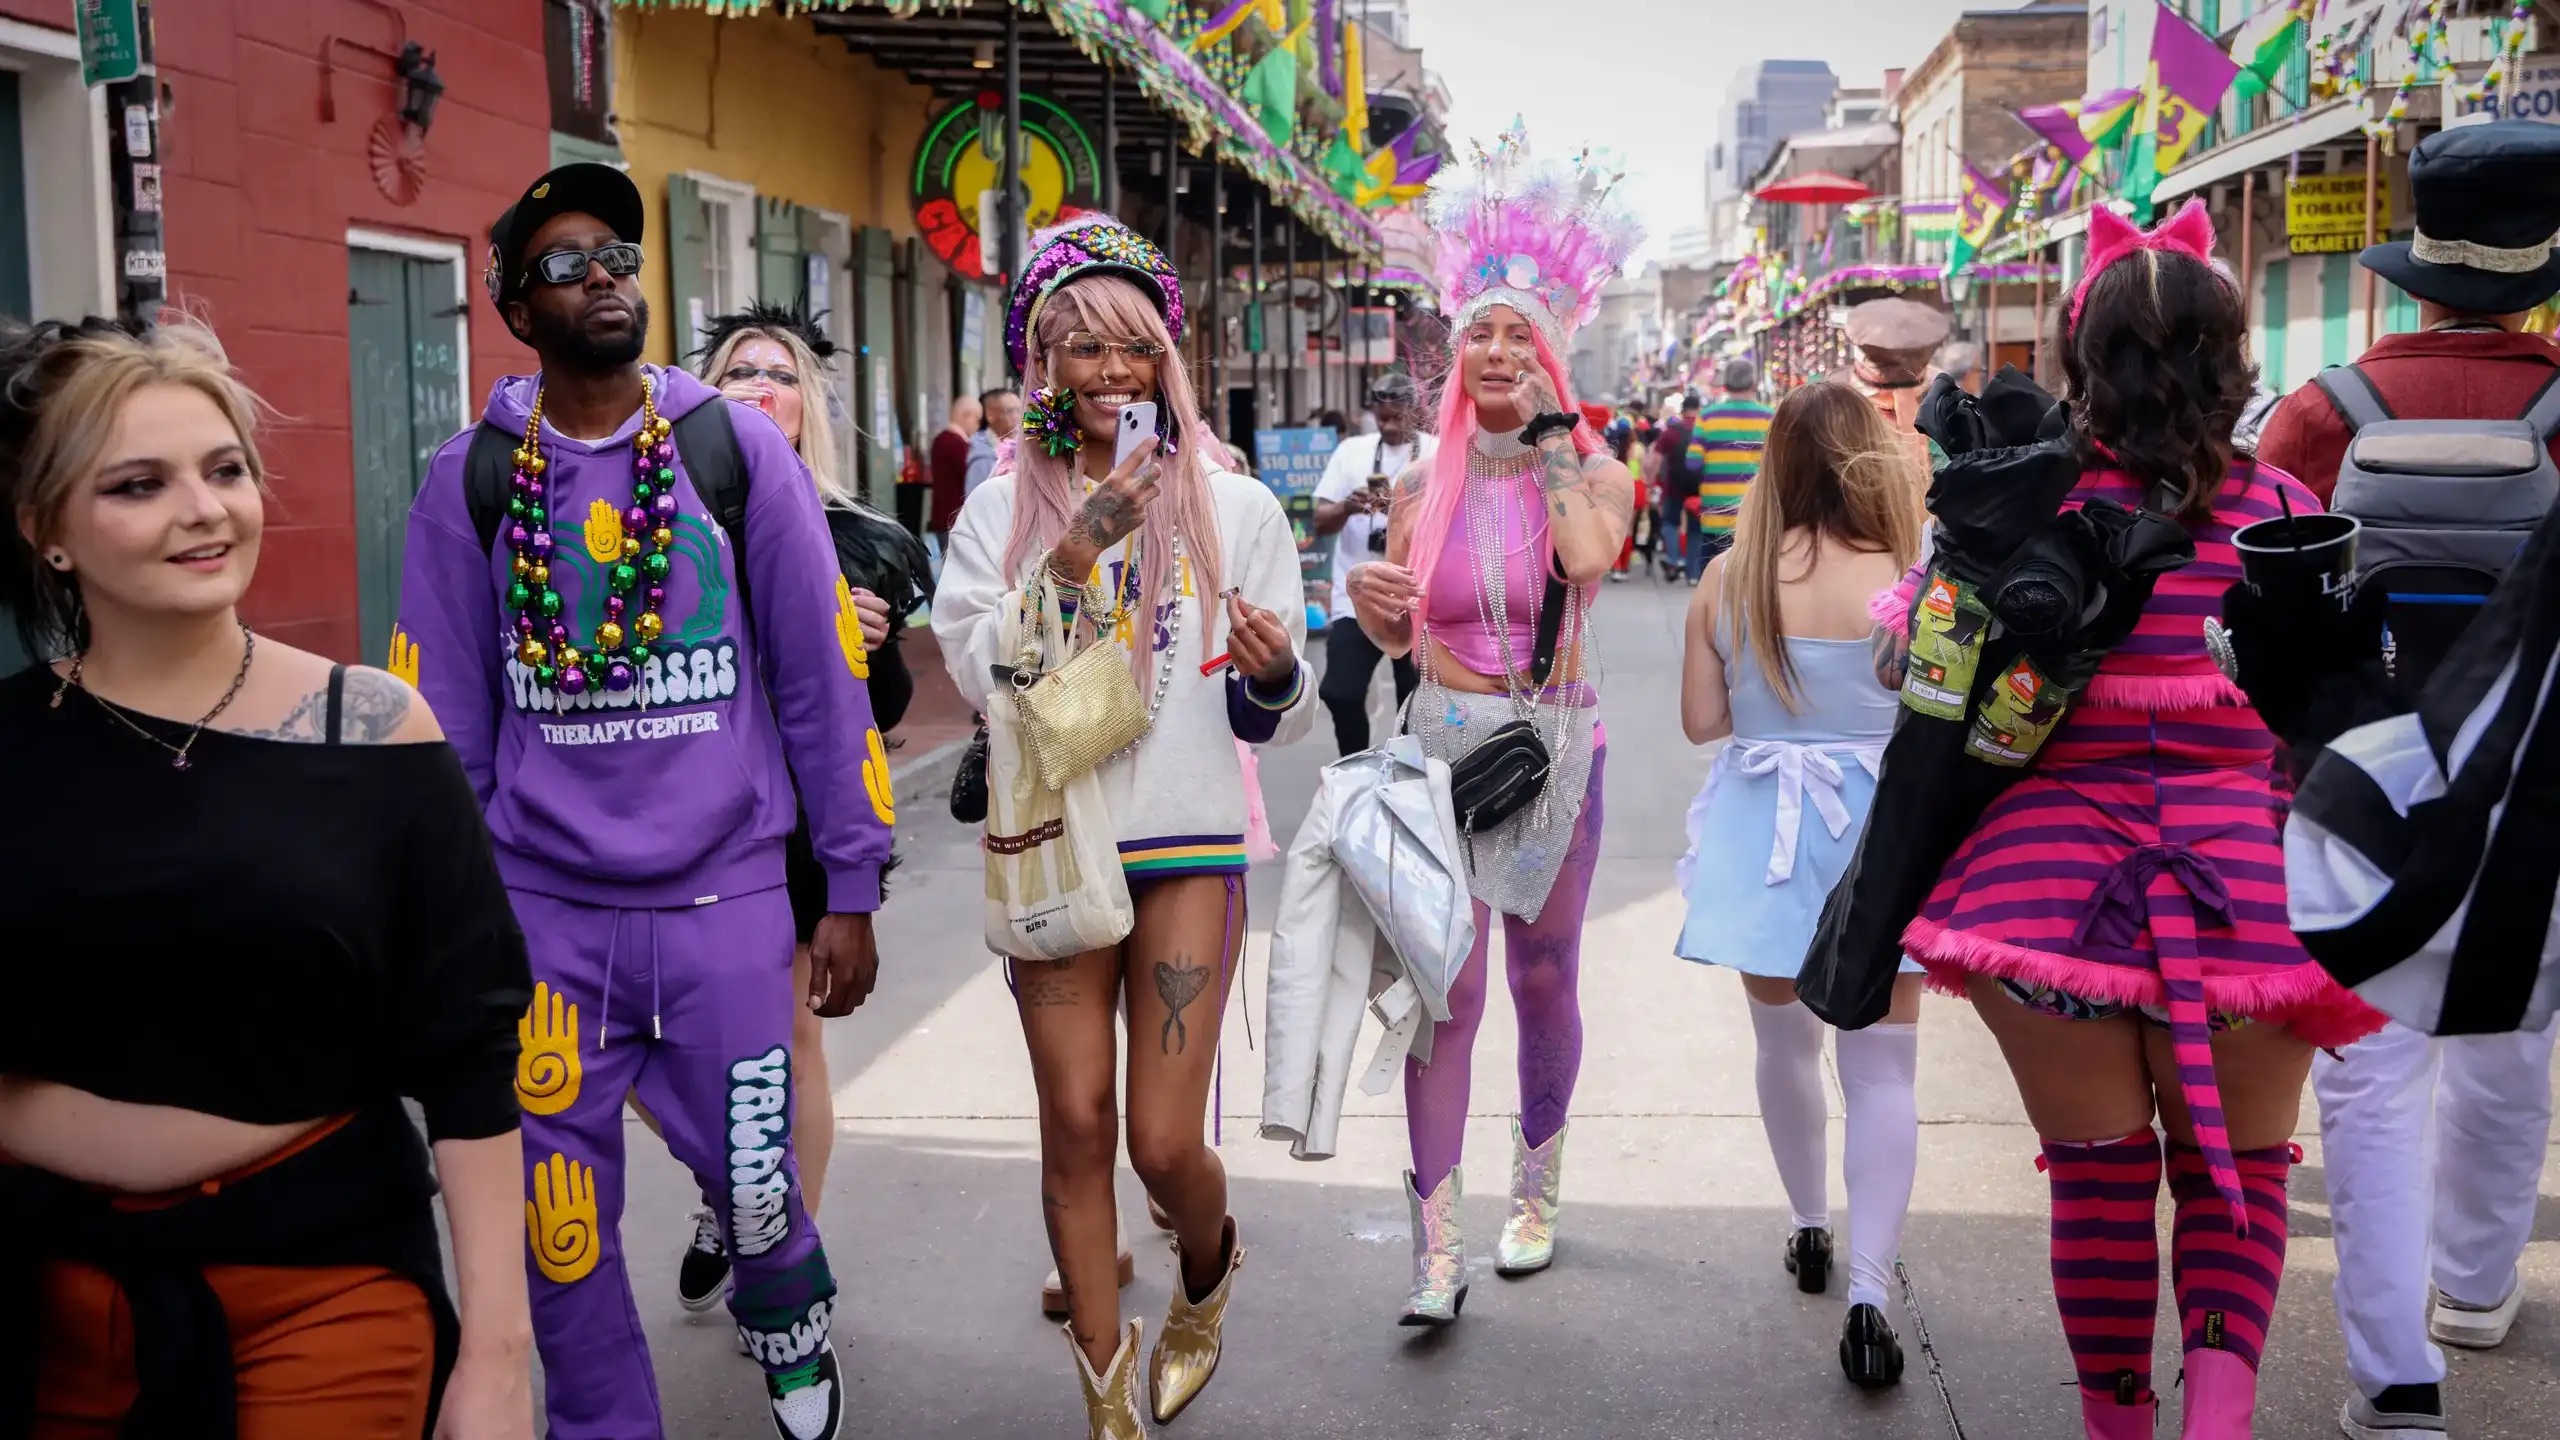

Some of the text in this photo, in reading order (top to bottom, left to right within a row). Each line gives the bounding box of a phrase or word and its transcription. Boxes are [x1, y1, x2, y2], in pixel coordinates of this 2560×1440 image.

[539, 710, 720, 746] THERAPY CENTER
[1978, 714, 1993, 730] CHAIR
